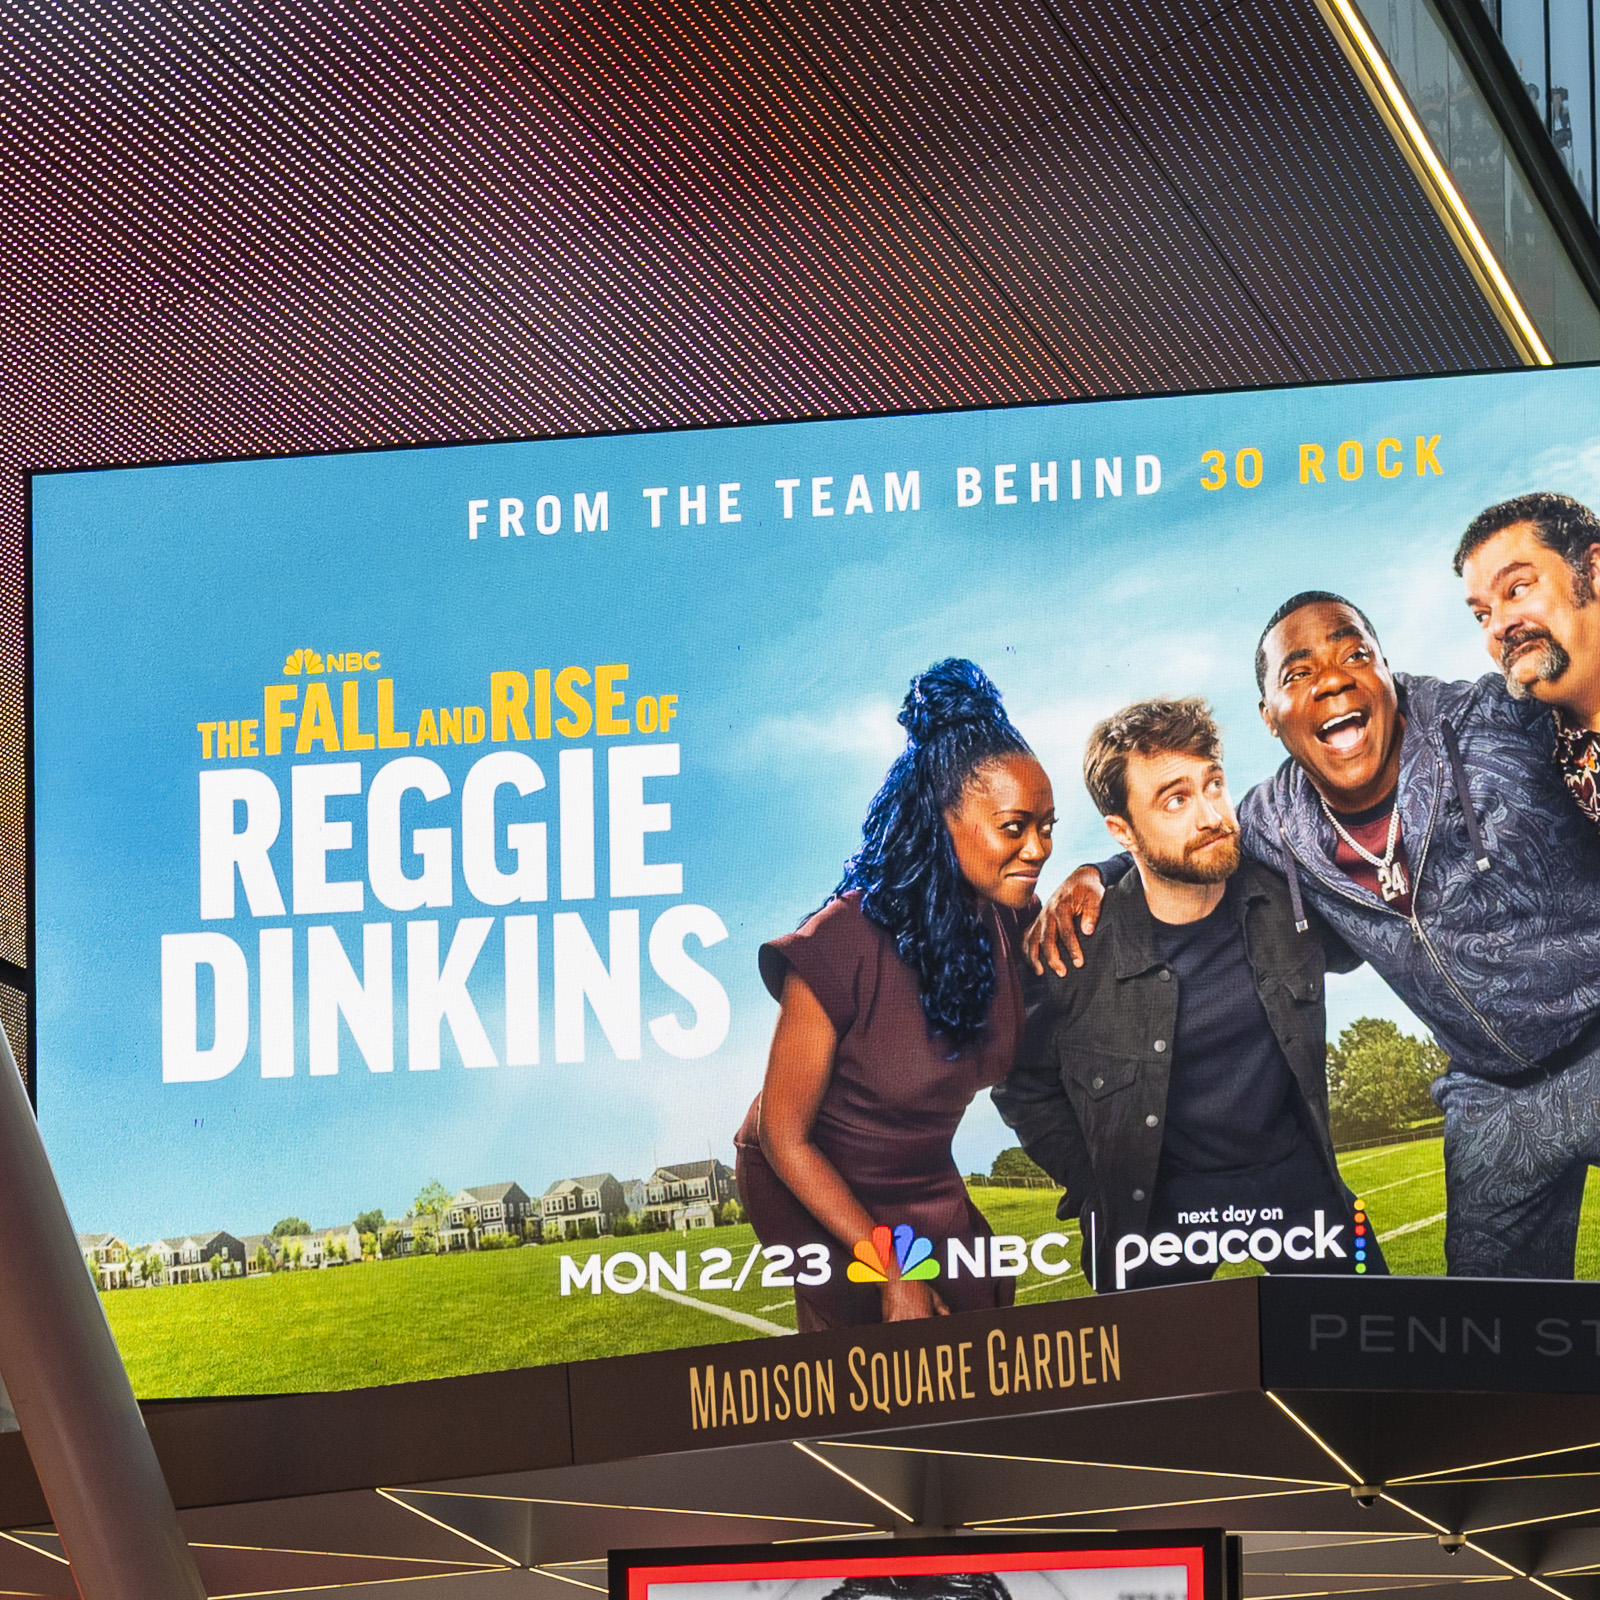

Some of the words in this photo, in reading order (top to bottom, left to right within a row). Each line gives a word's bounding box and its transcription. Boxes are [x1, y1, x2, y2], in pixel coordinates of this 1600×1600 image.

[467, 489, 610, 541] FROM
[642, 482, 743, 530] THE
[775, 470, 923, 520] TEAM
[957, 453, 1164, 508] BEHIND
[1200, 446, 1265, 491] 30
[1298, 433, 1446, 484] ROCK
[326, 650, 382, 673] NBC
[197, 718, 260, 760] THE
[264, 678, 410, 756] FALL
[415, 705, 486, 747] AND
[490, 663, 630, 742] RISE
[635, 694, 679, 734] OF
[199, 742, 683, 921] REGGIE
[1377, 861, 1410, 902] 24
[160, 903, 731, 1085] DINKINS
[1114, 1209, 1348, 1290] peacock
[1177, 1208, 1224, 1226] next
[1227, 1206, 1254, 1227] day
[1257, 1206, 1284, 1222] on
[560, 1251, 688, 1297] MON
[698, 1242, 832, 1292] 2/23
[947, 1233, 1072, 1280] NBC
[1309, 1312, 1501, 1357] PENN
[688, 1358, 835, 1431] MADISON
[847, 1340, 973, 1413] SQUARE
[988, 1322, 1122, 1393] GARDEN
